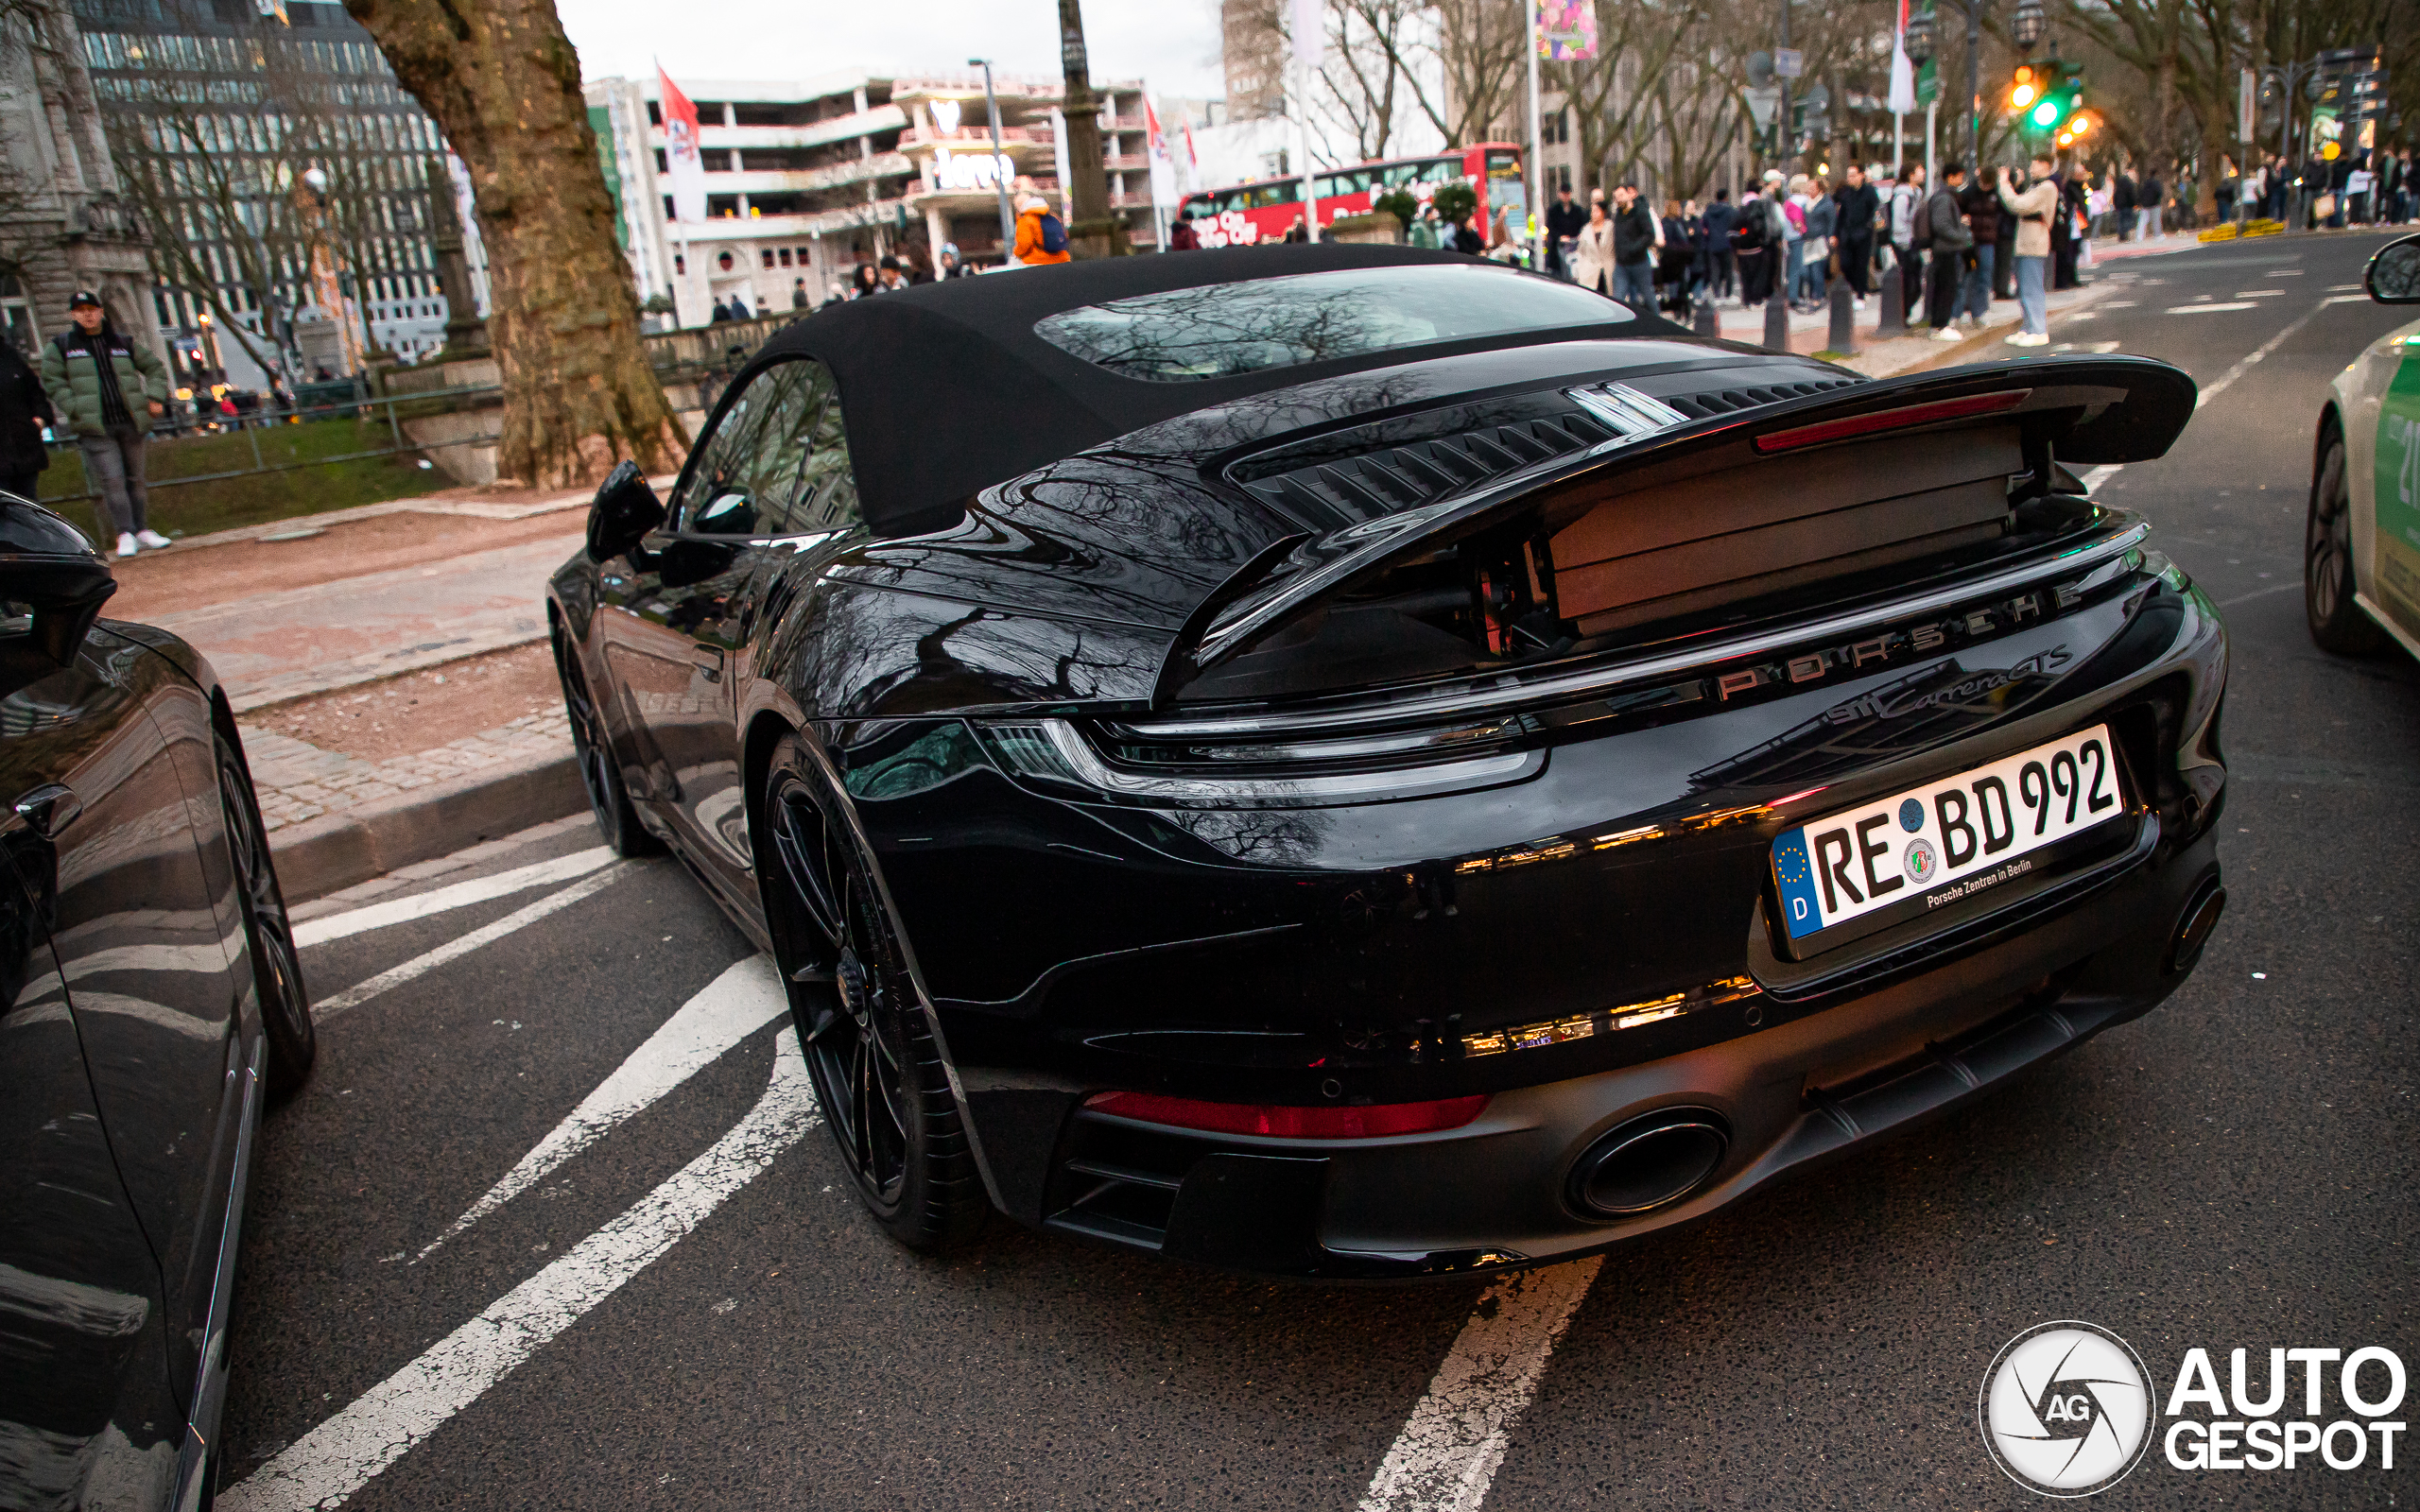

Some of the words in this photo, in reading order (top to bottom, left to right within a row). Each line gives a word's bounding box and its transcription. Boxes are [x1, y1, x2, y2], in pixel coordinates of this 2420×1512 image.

[1718, 580, 2082, 701] PORSCHE
[1825, 695, 1885, 726] 911
[1879, 673, 2009, 719] Carrera
[2008, 643, 2073, 681] GTS
[1813, 813, 1905, 913] RE
[1933, 775, 2014, 869] BD
[2019, 739, 2114, 836] 992
[1792, 897, 1808, 921] D
[1927, 887, 1963, 907] Porsche
[1963, 873, 1996, 893] Zentren
[1997, 869, 2006, 881] in
[2007, 860, 2031, 876] Berlin
